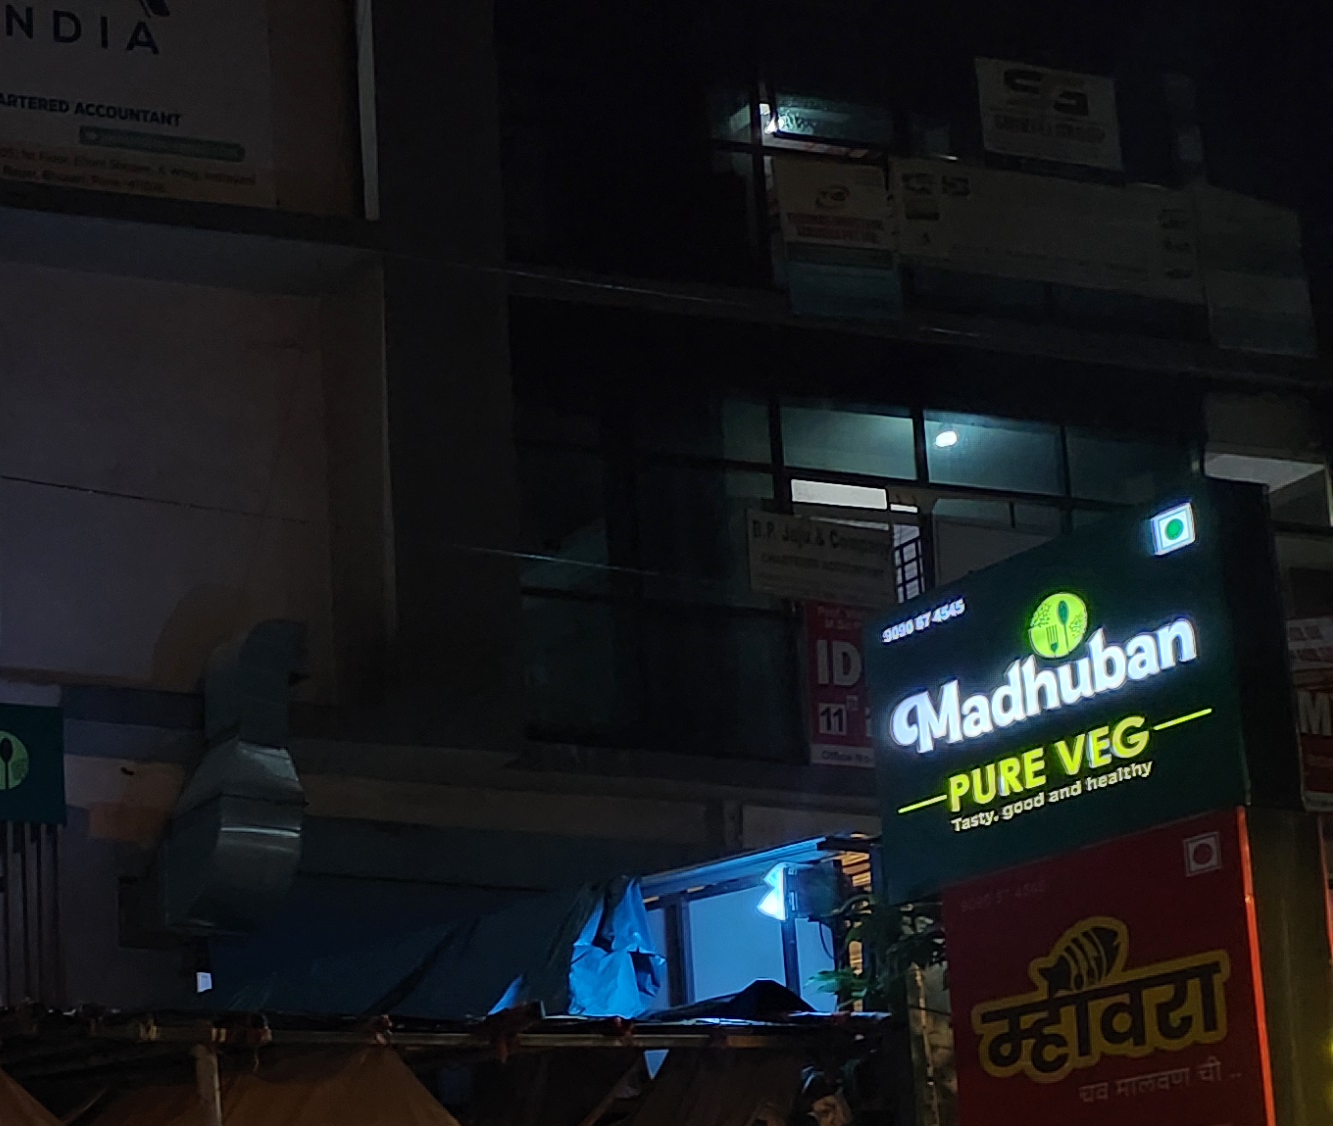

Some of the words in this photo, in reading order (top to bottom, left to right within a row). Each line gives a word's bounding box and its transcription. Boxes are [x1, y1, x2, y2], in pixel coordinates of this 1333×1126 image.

[74, 102, 181, 126] ACCOUNTANT
[890, 616, 1197, 755] Madhuban
[950, 747, 1046, 812] PURE
[1054, 713, 1150, 776] VEG
[1002, 792, 1045, 820] good
[1048, 781, 1082, 802] and
[1086, 760, 1153, 791] healthy
